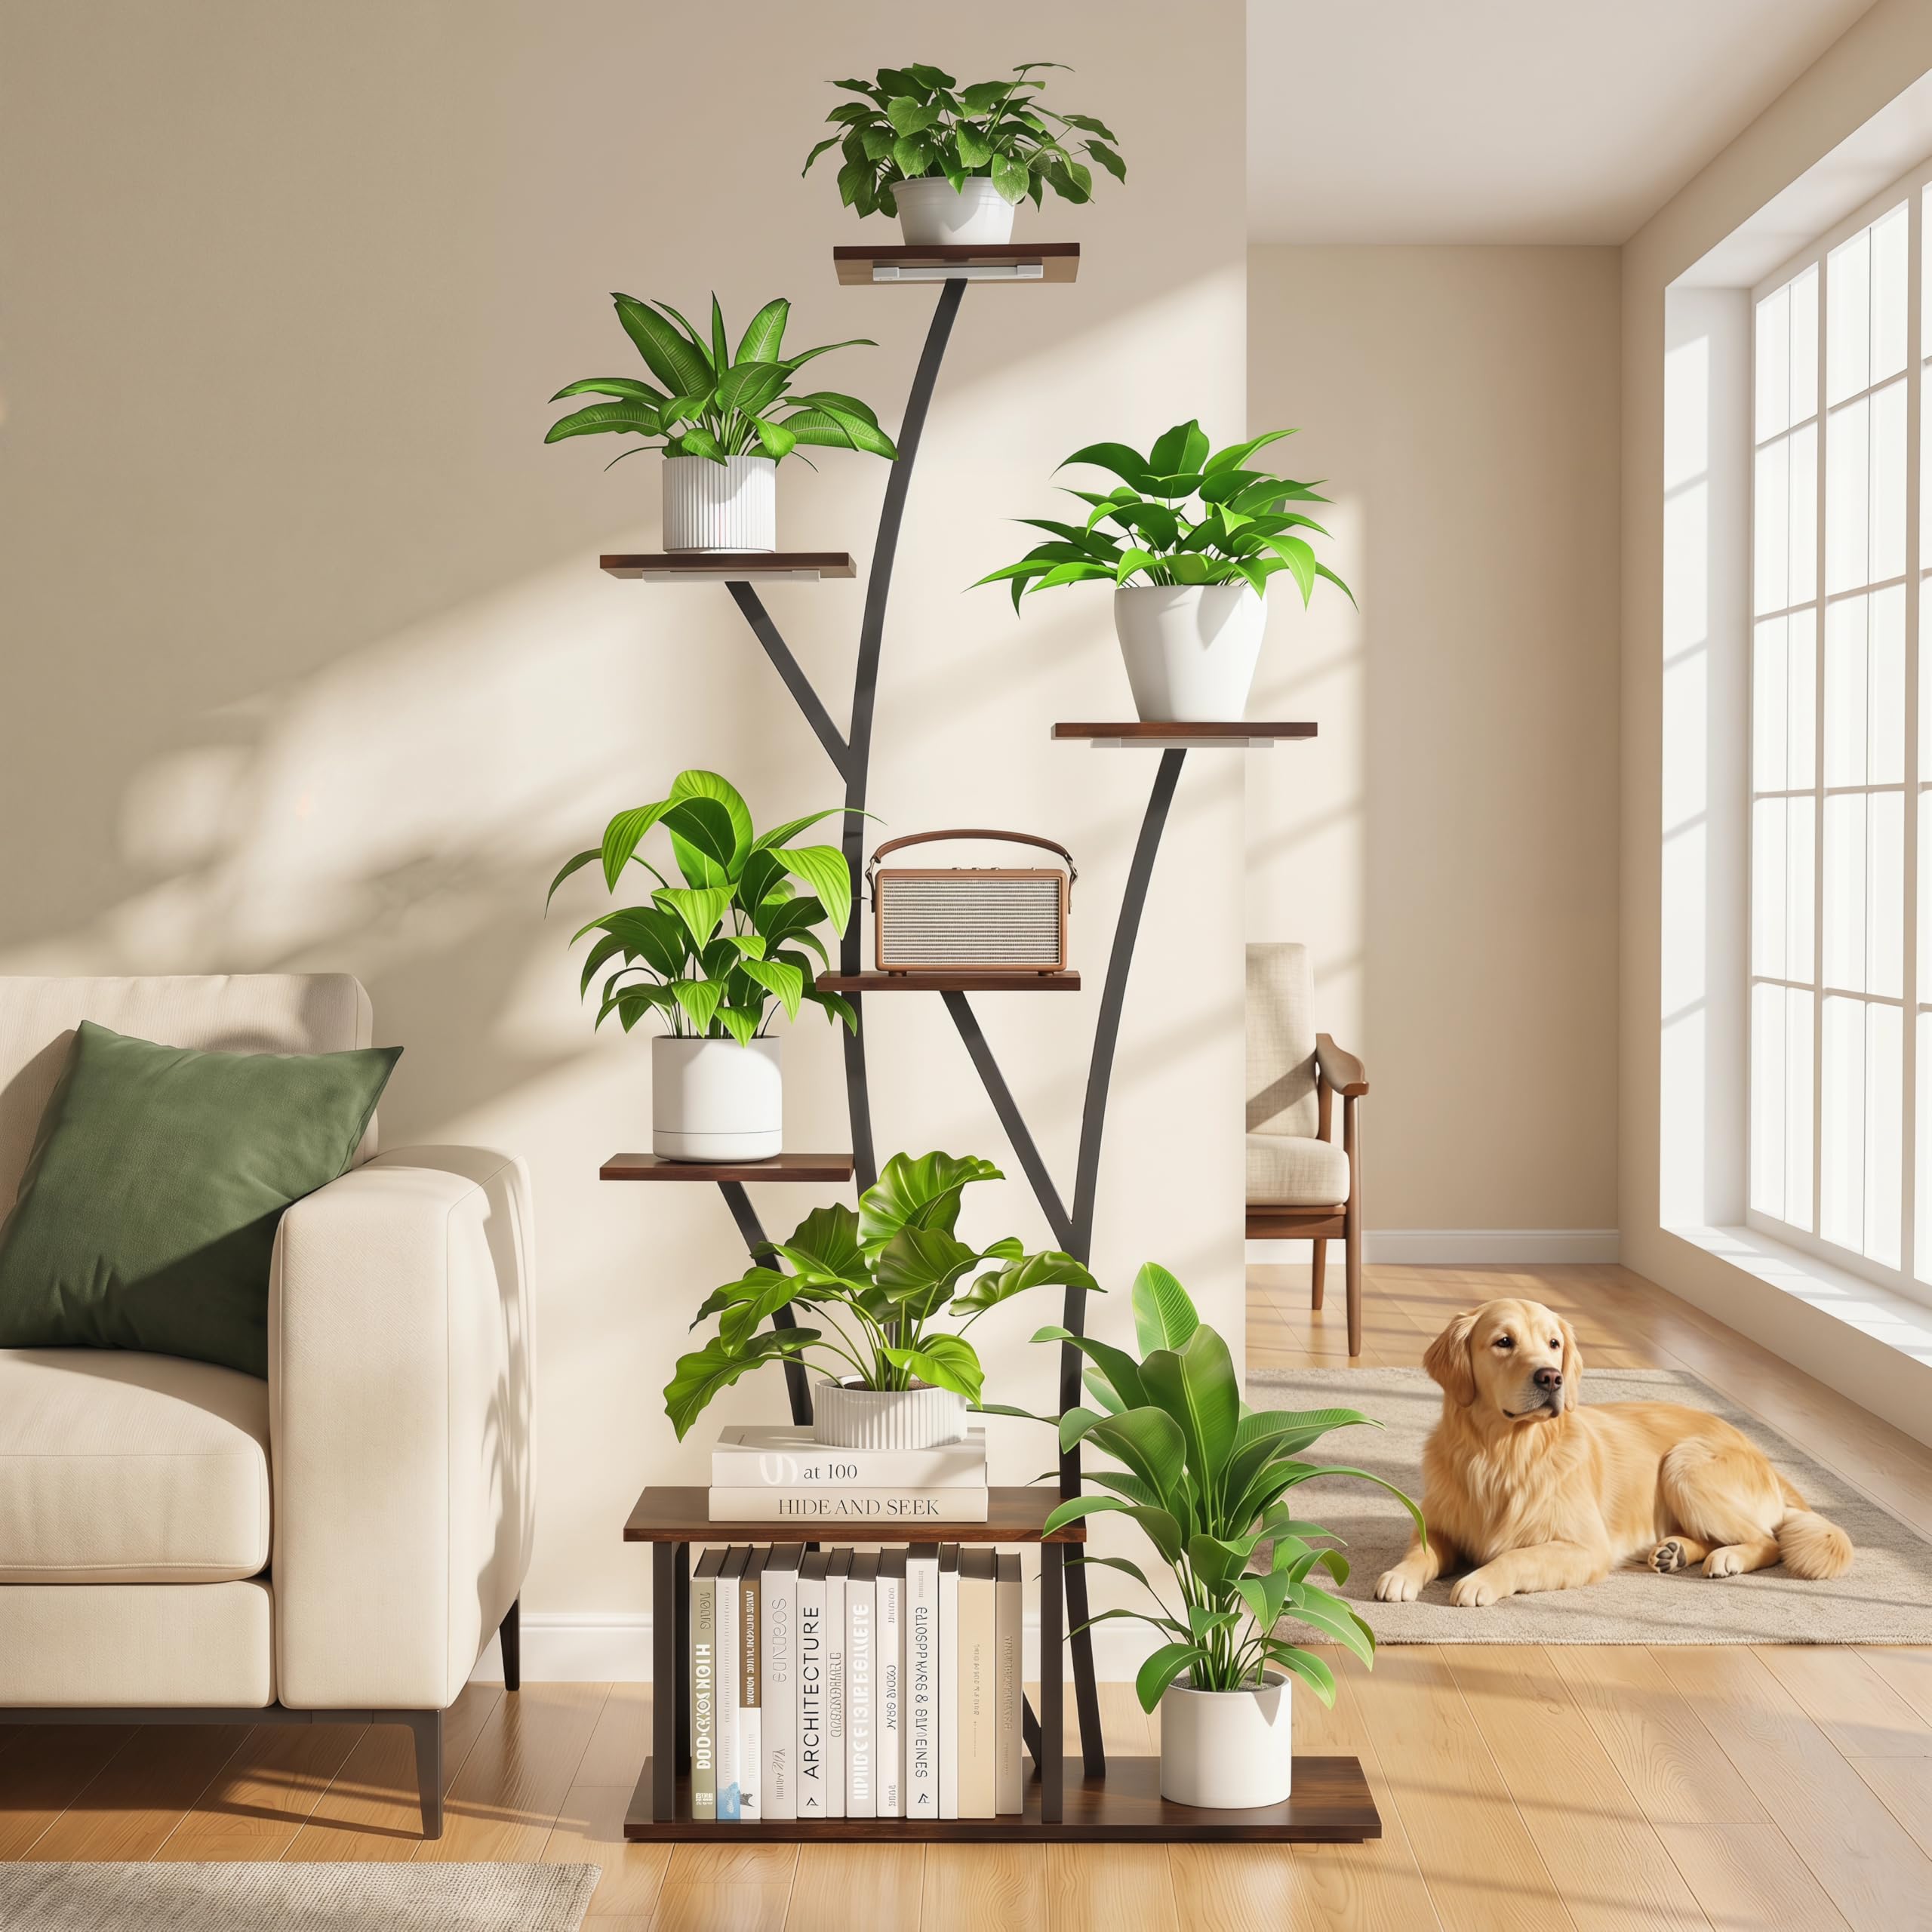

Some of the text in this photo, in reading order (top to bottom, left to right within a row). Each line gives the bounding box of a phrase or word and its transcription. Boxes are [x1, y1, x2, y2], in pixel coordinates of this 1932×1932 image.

[803, 1466, 821, 1480] at
[827, 1463, 859, 1480] 100
[778, 1499, 940, 1515] HIDE AND SEEK
[802, 1607, 820, 1780] ARCHITECTURE
